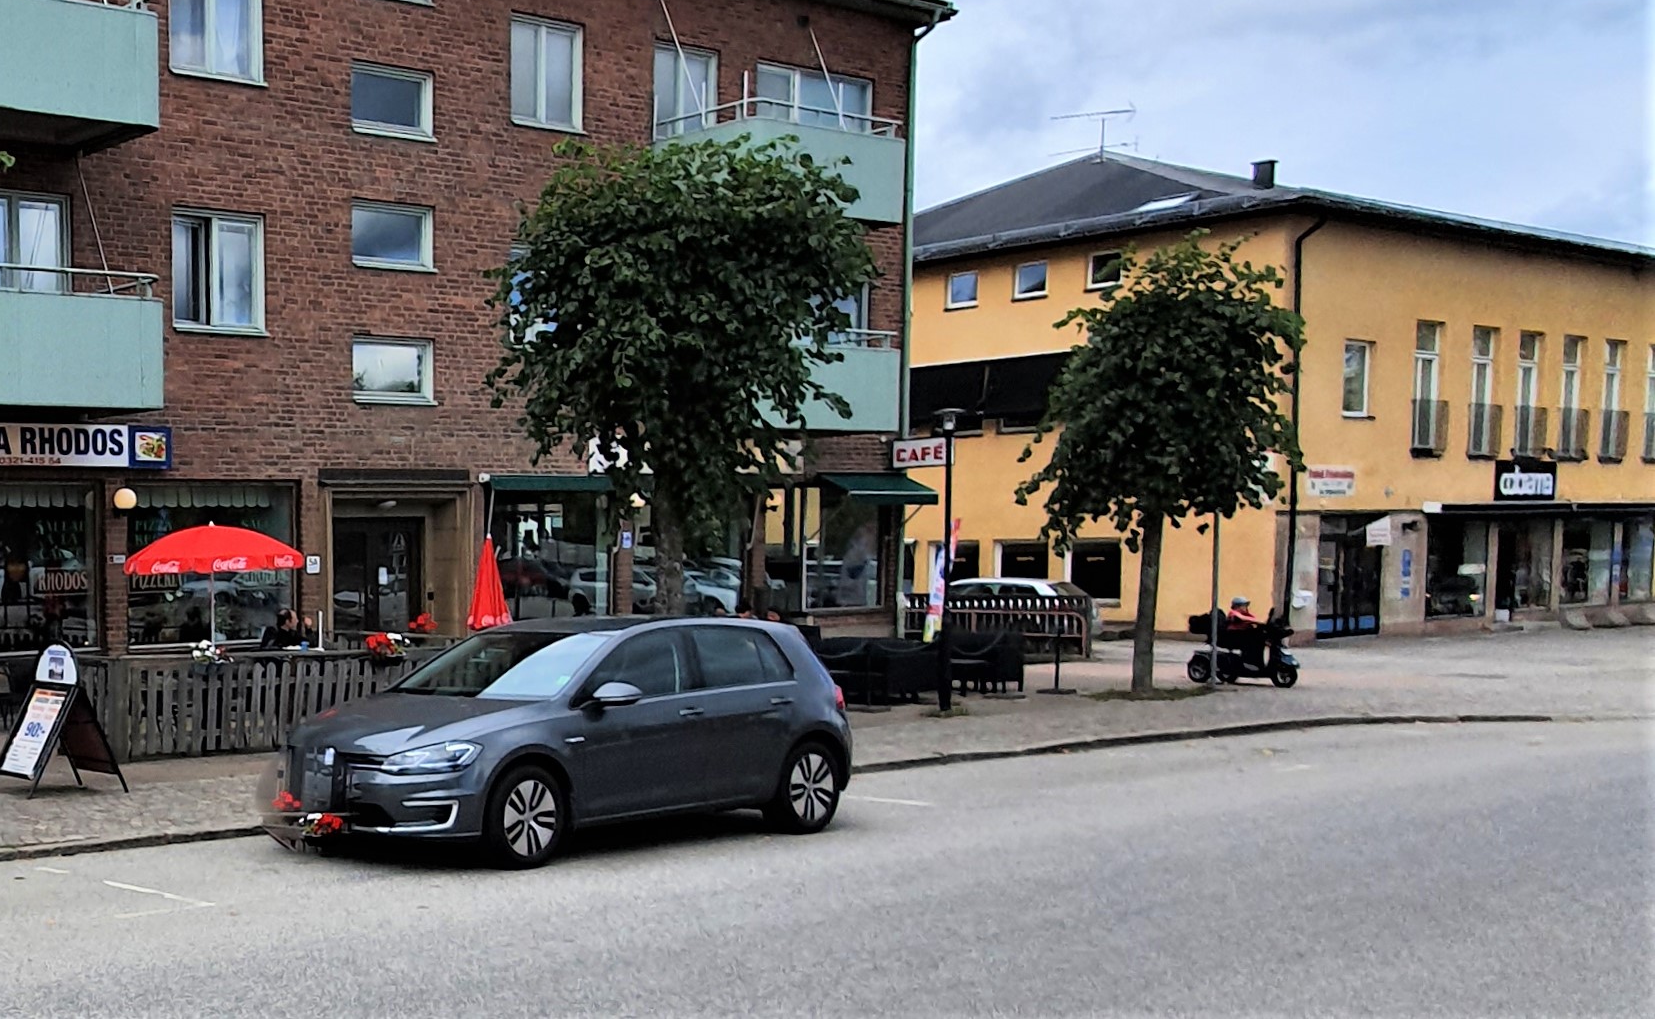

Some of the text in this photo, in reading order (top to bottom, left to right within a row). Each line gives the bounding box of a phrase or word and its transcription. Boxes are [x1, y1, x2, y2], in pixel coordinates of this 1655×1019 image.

[20, 427, 124, 456] RHODOS
[895, 442, 943, 462] CAFÉ
[38, 571, 88, 591] RHODOS
